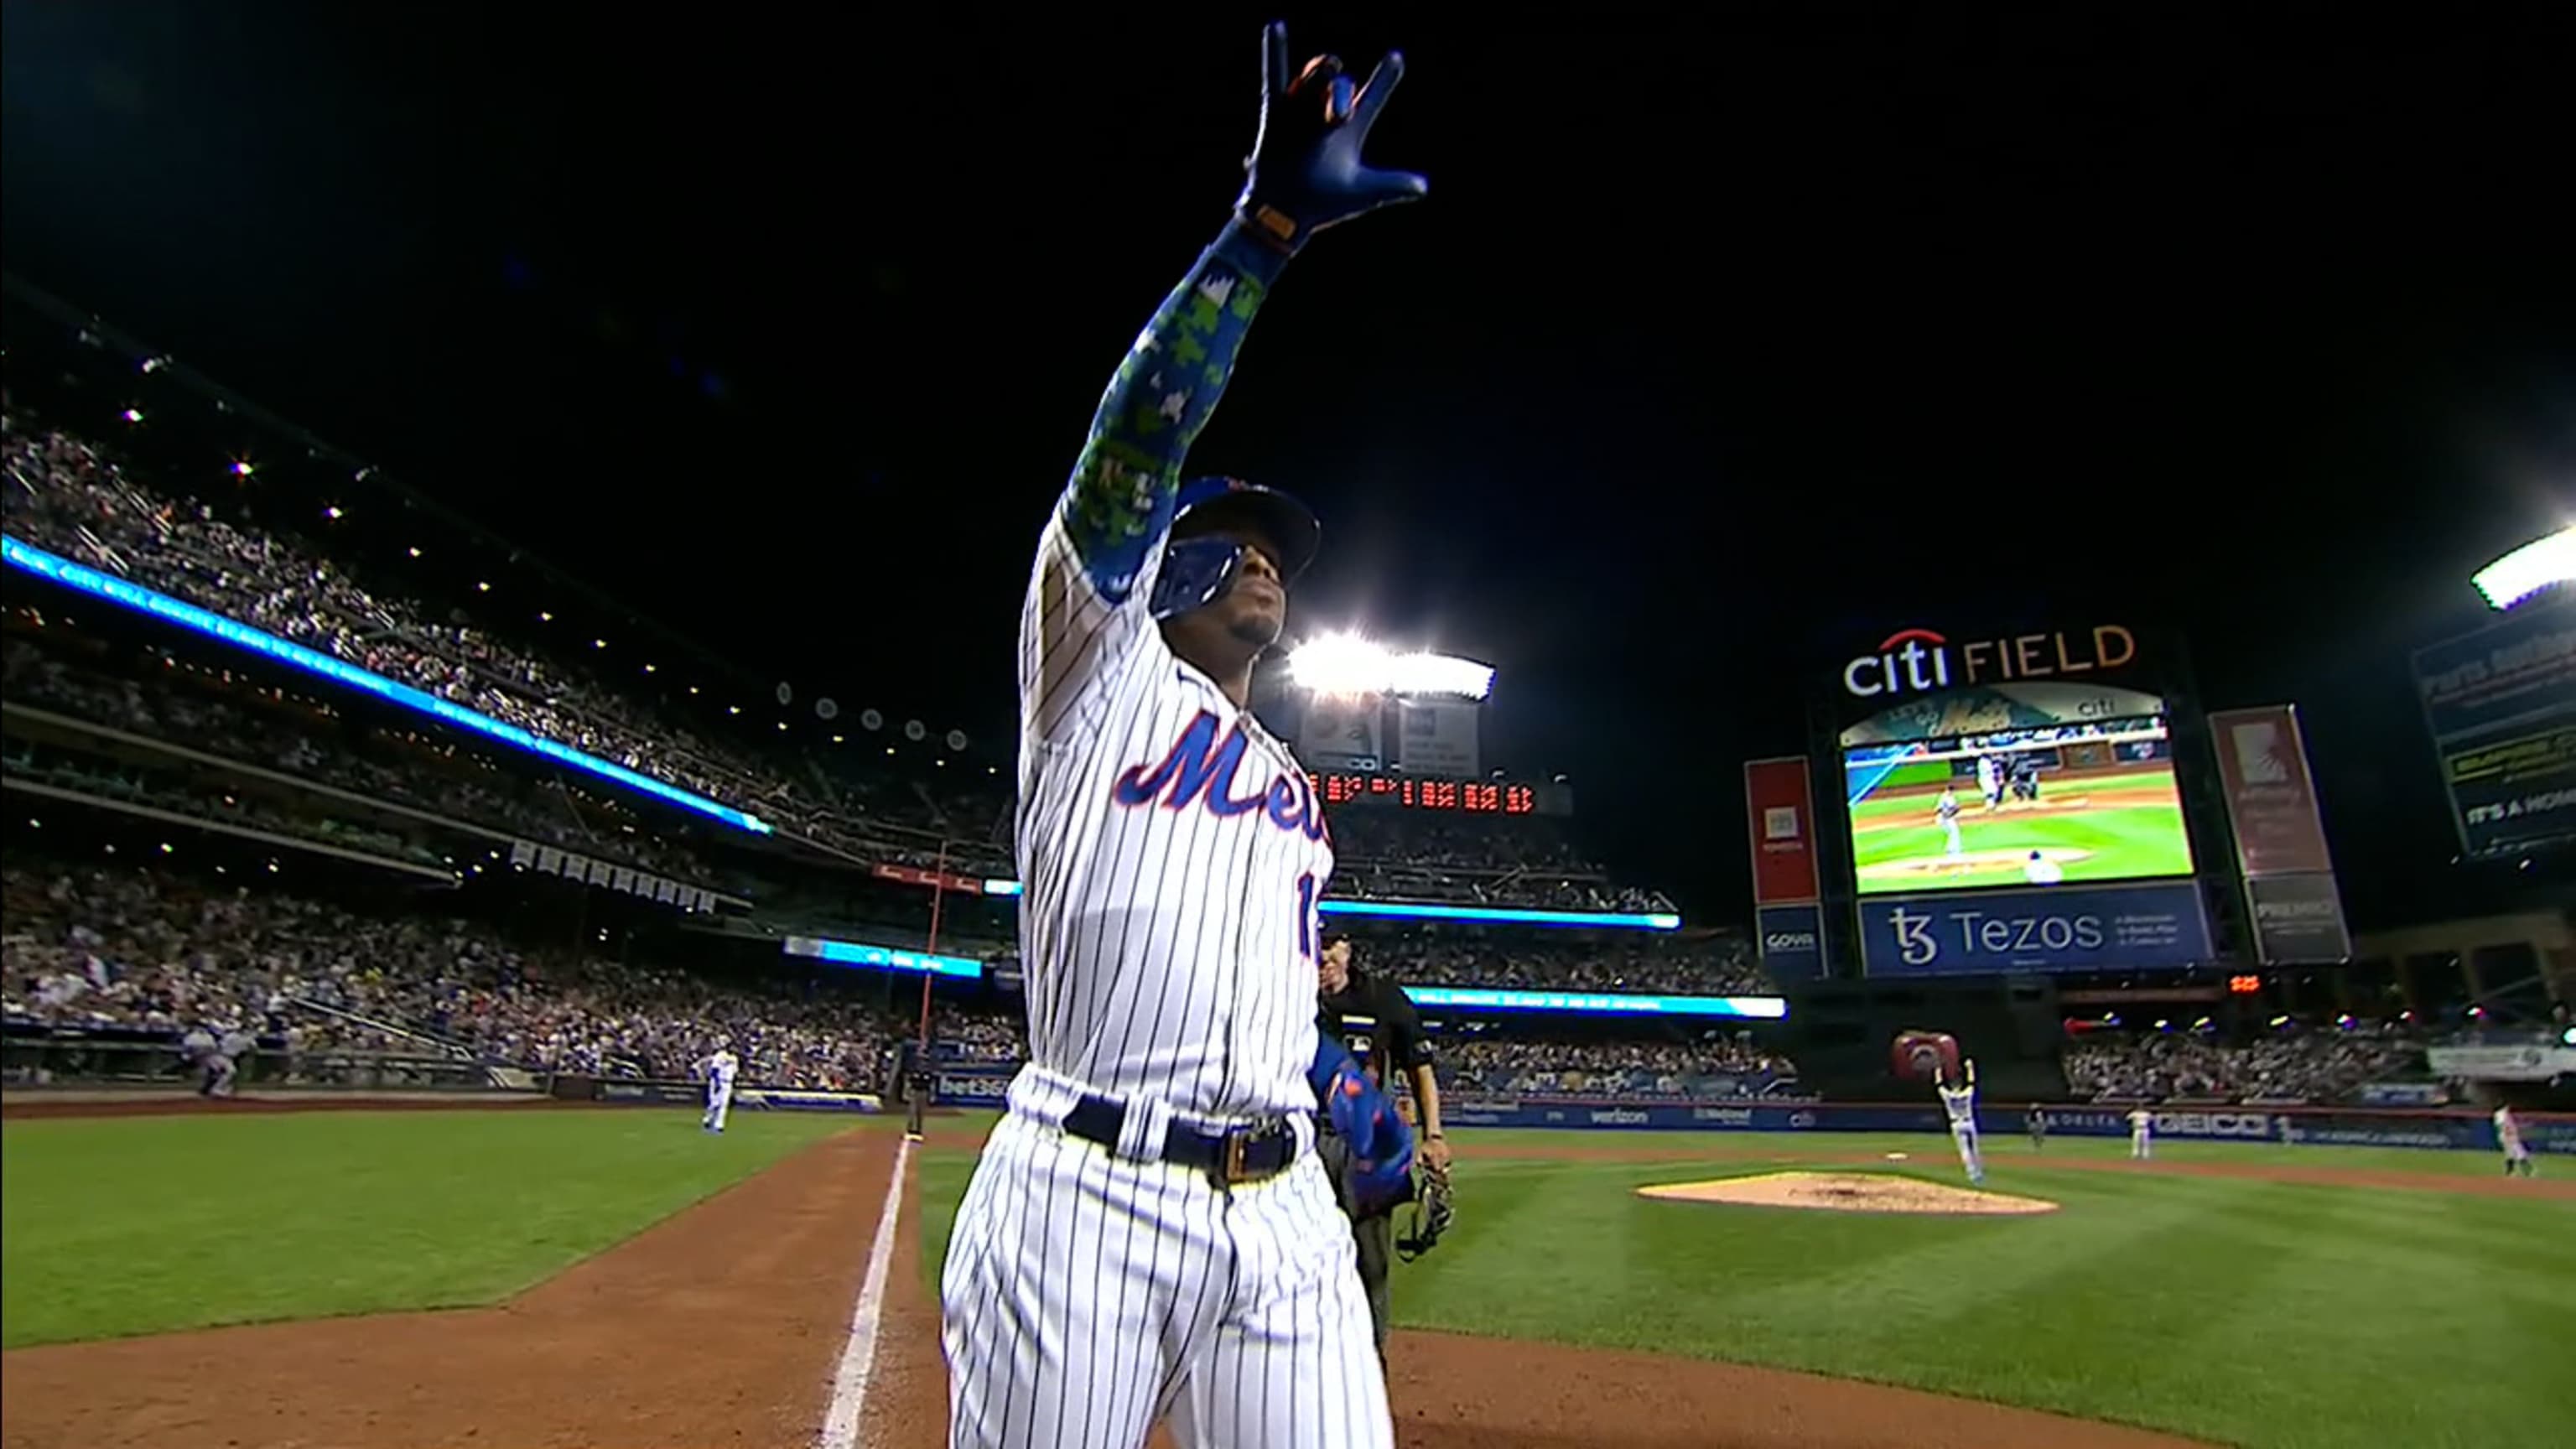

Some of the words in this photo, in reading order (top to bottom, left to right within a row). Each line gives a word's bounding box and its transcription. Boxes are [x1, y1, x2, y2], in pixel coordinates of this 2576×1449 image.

[1843, 639, 1948, 697] citi
[1964, 625, 2135, 683] FIELD
[1114, 708, 1332, 847] Met
[2507, 798, 2523, 818] A
[1949, 910, 2103, 953] Tezos
[939, 1075, 1007, 1096] bet36
[1591, 1106, 1649, 1125] verizon
[2153, 1113, 2267, 1135] GEICO
